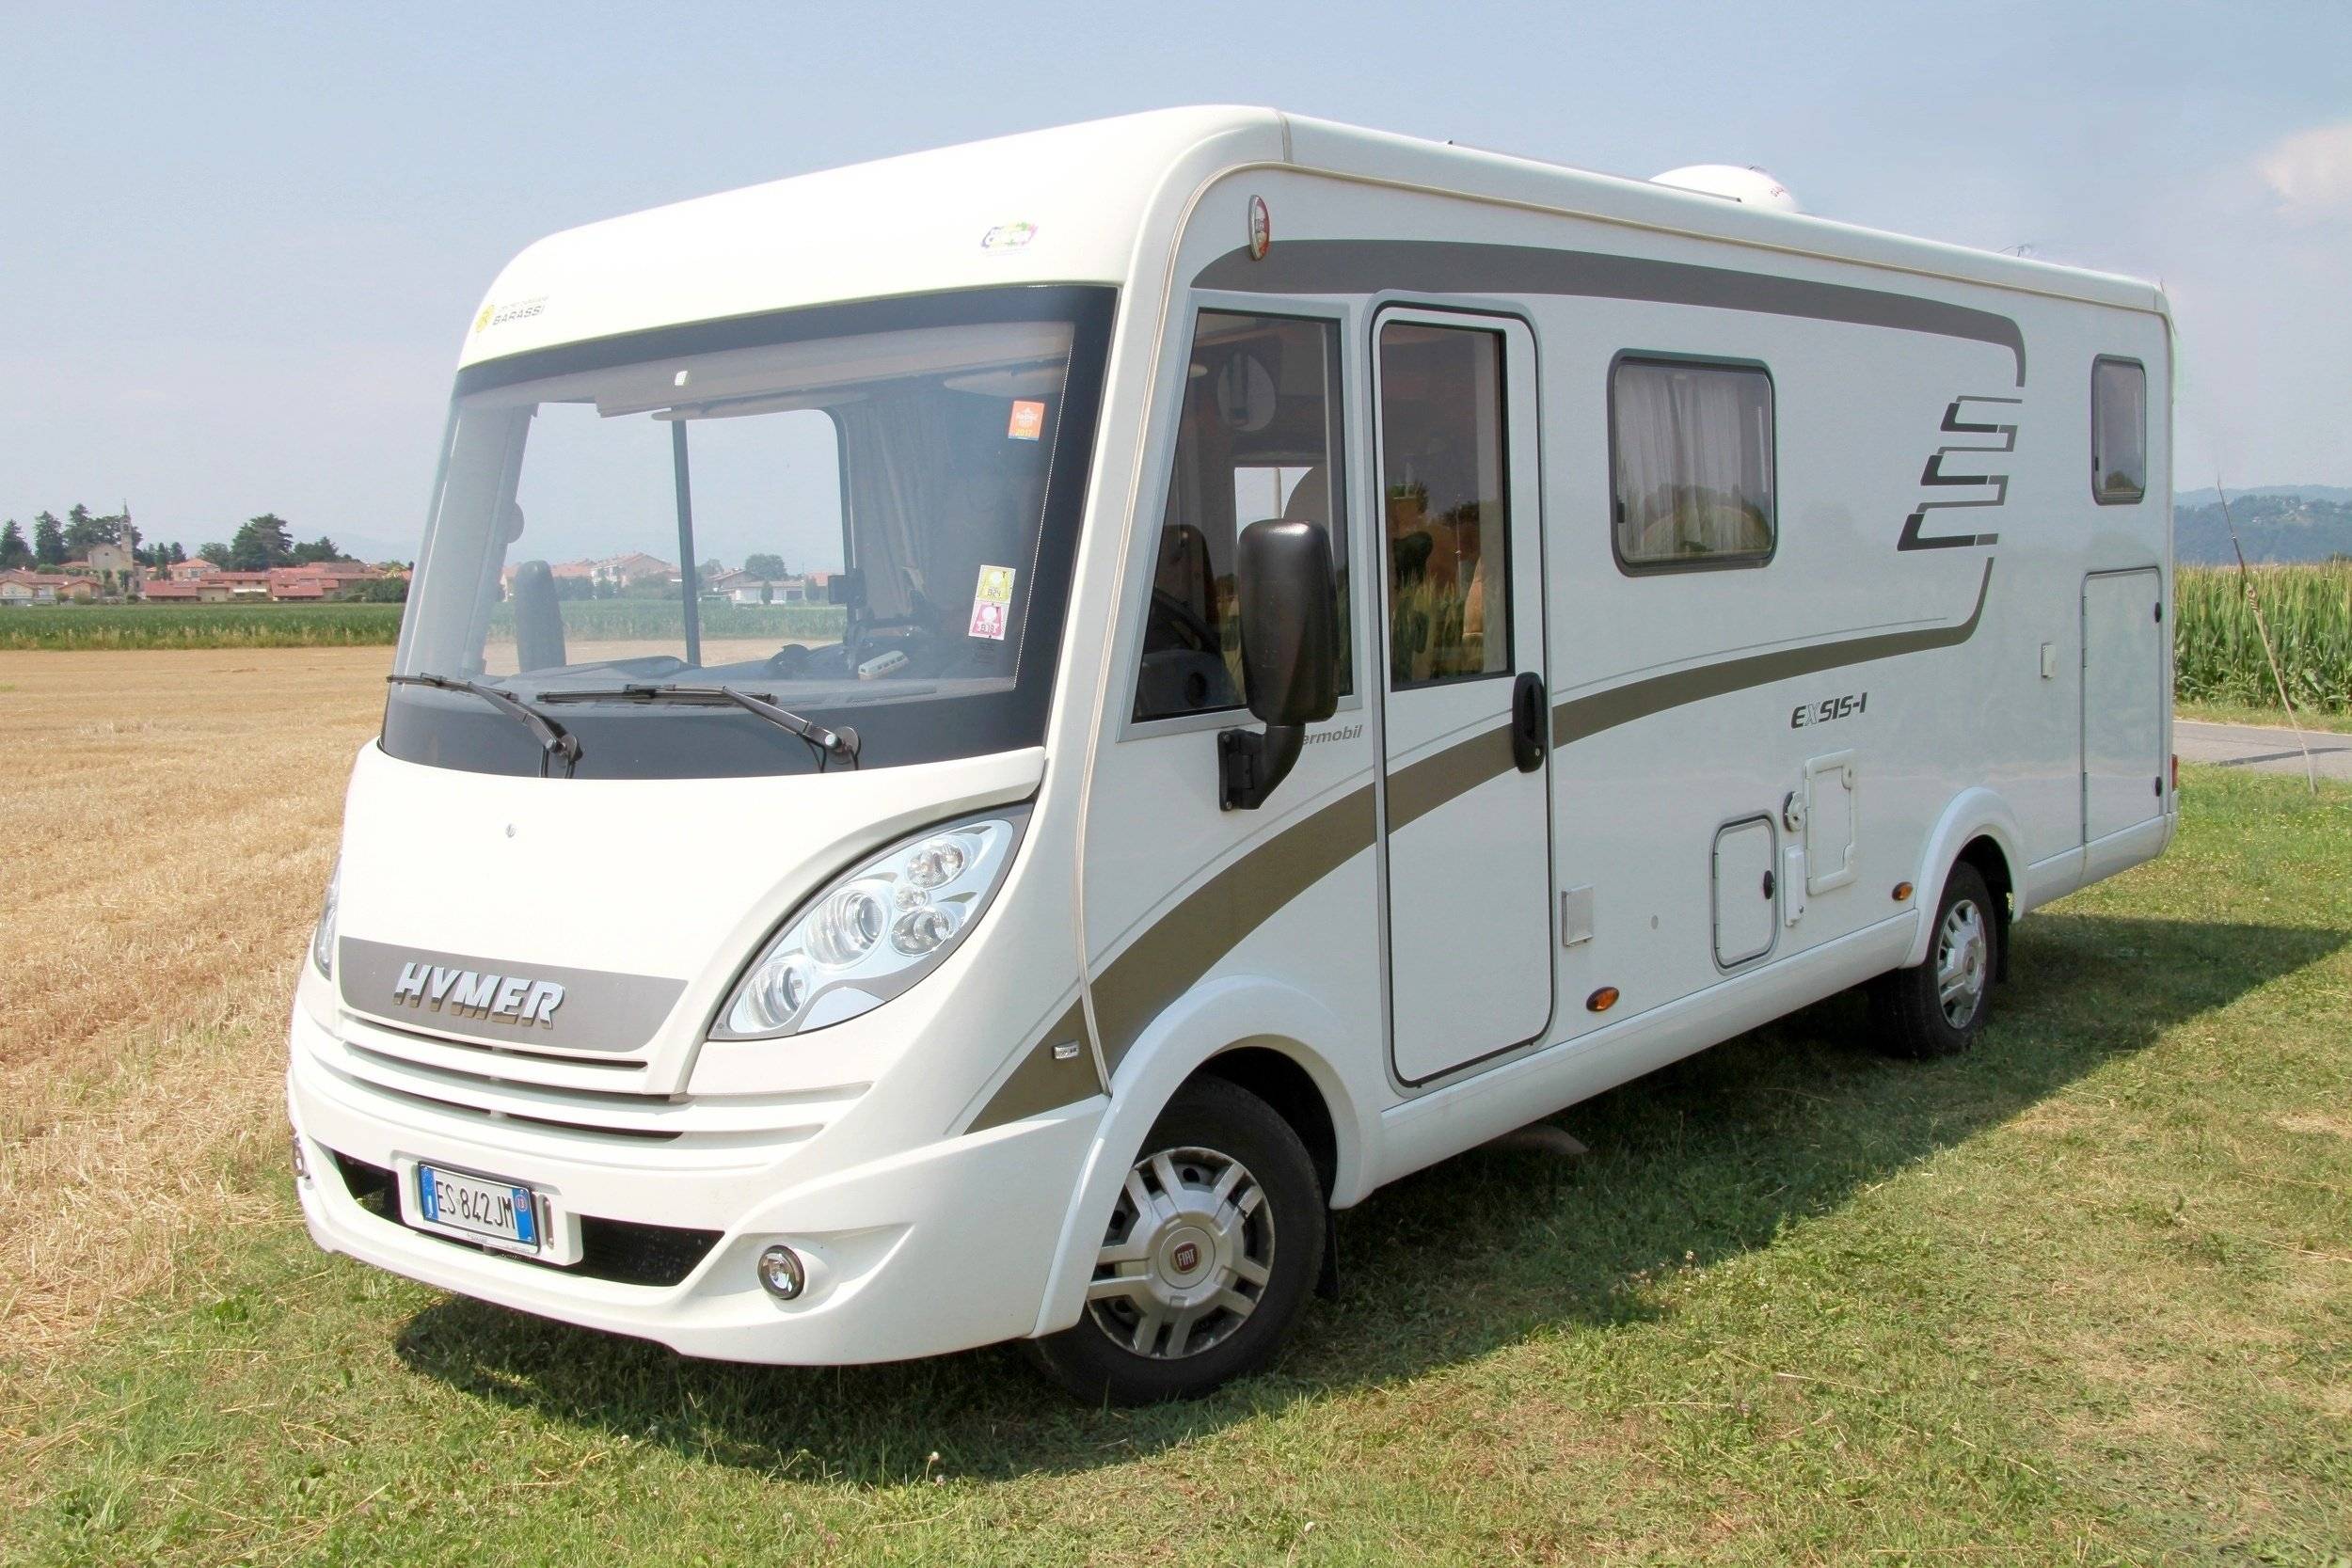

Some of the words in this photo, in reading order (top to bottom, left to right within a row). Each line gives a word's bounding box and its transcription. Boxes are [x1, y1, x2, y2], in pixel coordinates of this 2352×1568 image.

[1303, 724, 1363, 745] ermobil
[392, 961, 565, 1029] HYMER
[435, 1180, 456, 1215] ES
[459, 1187, 516, 1230] 842JM
[1177, 1248, 1195, 1267] FIAT
